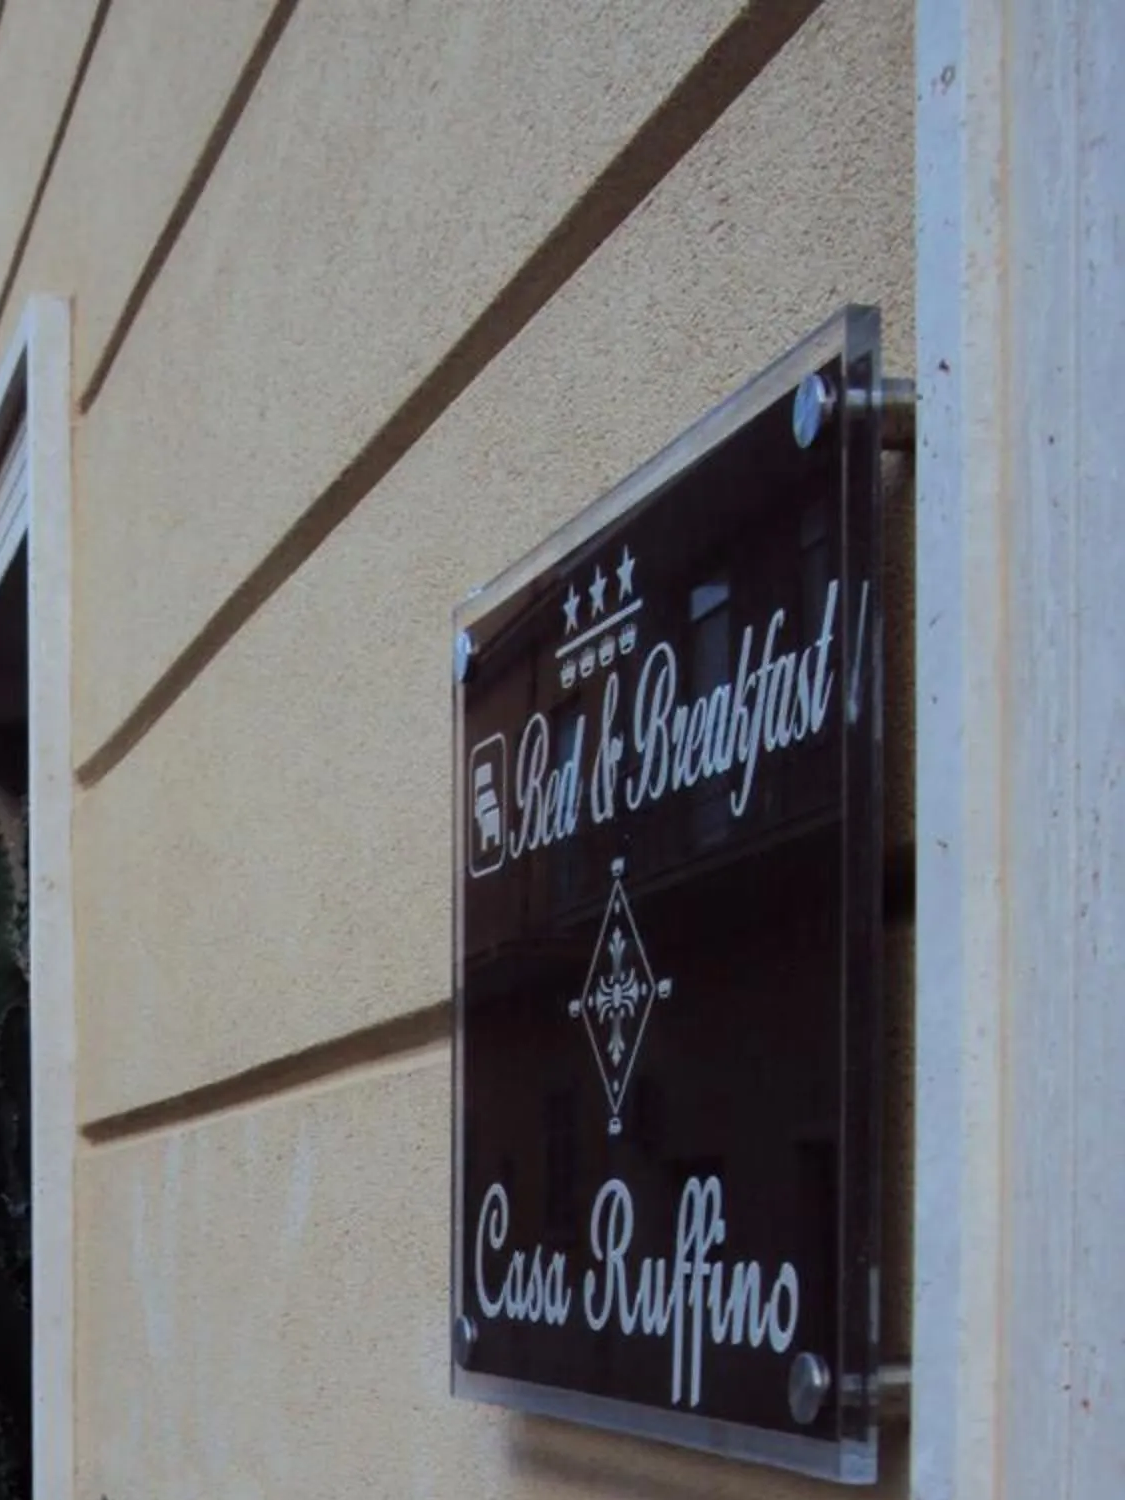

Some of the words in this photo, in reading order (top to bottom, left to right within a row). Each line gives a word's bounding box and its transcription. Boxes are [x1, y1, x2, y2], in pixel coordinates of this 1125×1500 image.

[509, 711, 585, 860] Bed
[590, 672, 623, 824] &
[626, 579, 838, 817] Breakfast
[475, 1182, 572, 1326] Casa
[583, 1175, 799, 1407] Ruffino
